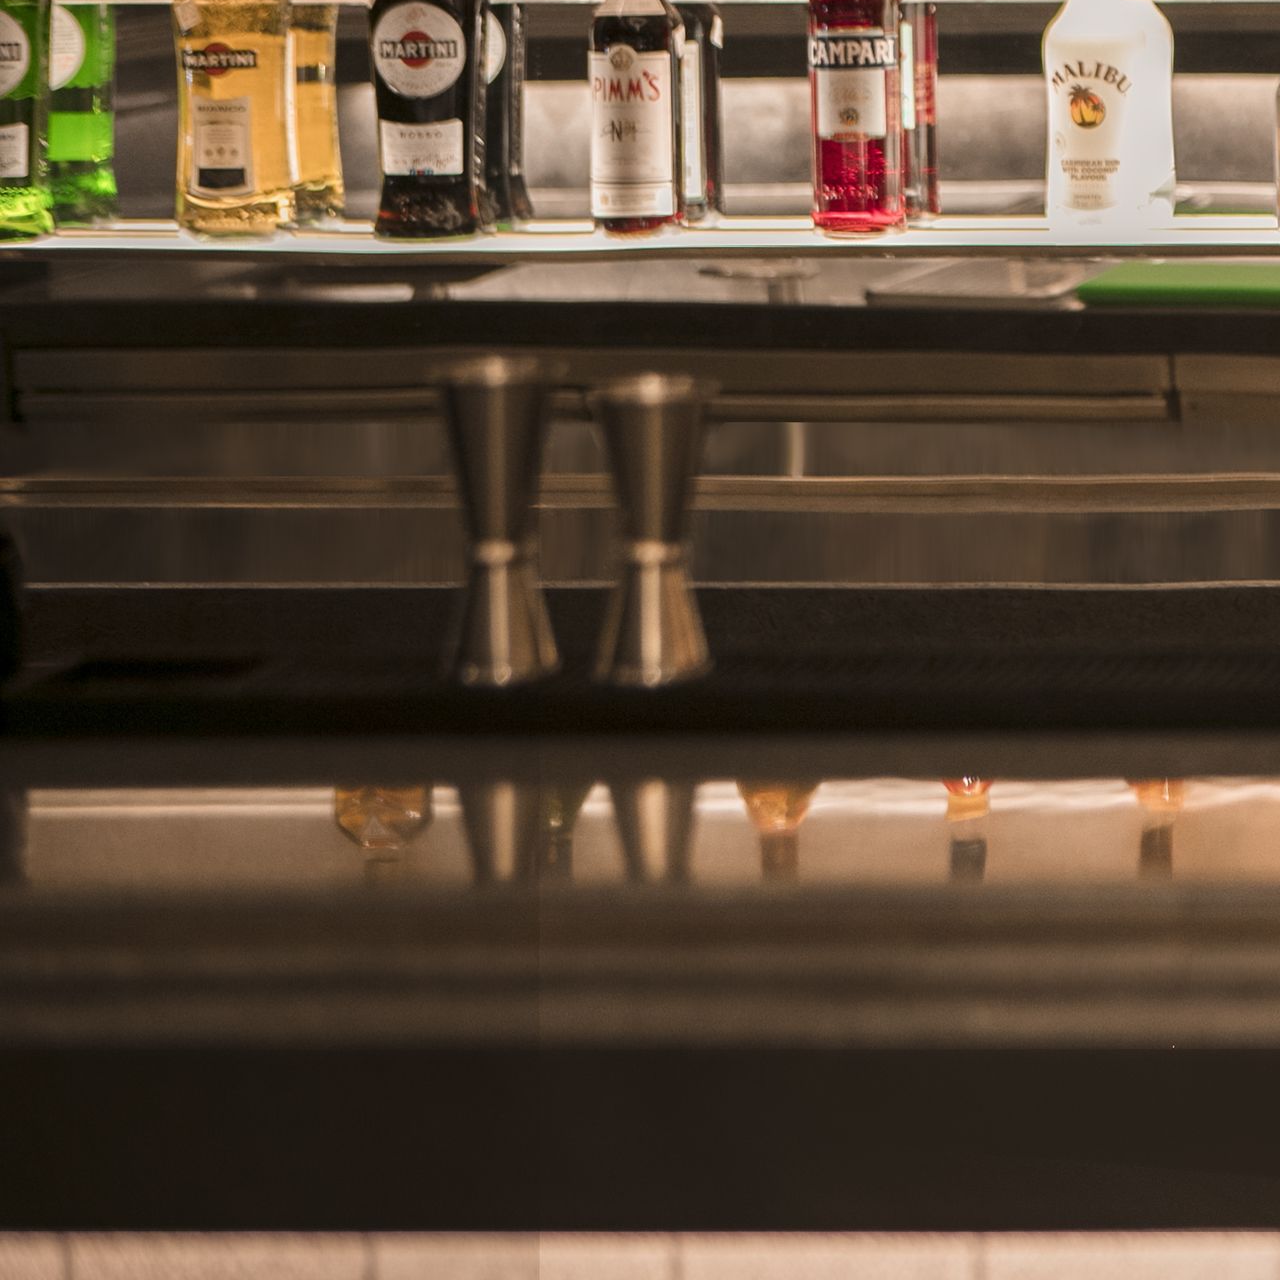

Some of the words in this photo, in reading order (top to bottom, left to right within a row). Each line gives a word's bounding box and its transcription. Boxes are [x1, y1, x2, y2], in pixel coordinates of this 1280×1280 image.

[184, 50, 256, 69] MARTINI
[382, 41, 457, 58] MARTINI
[809, 38, 897, 67] CAMPARI
[594, 70, 661, 103] PIMM'S
[1052, 61, 1132, 95] MALIBU
